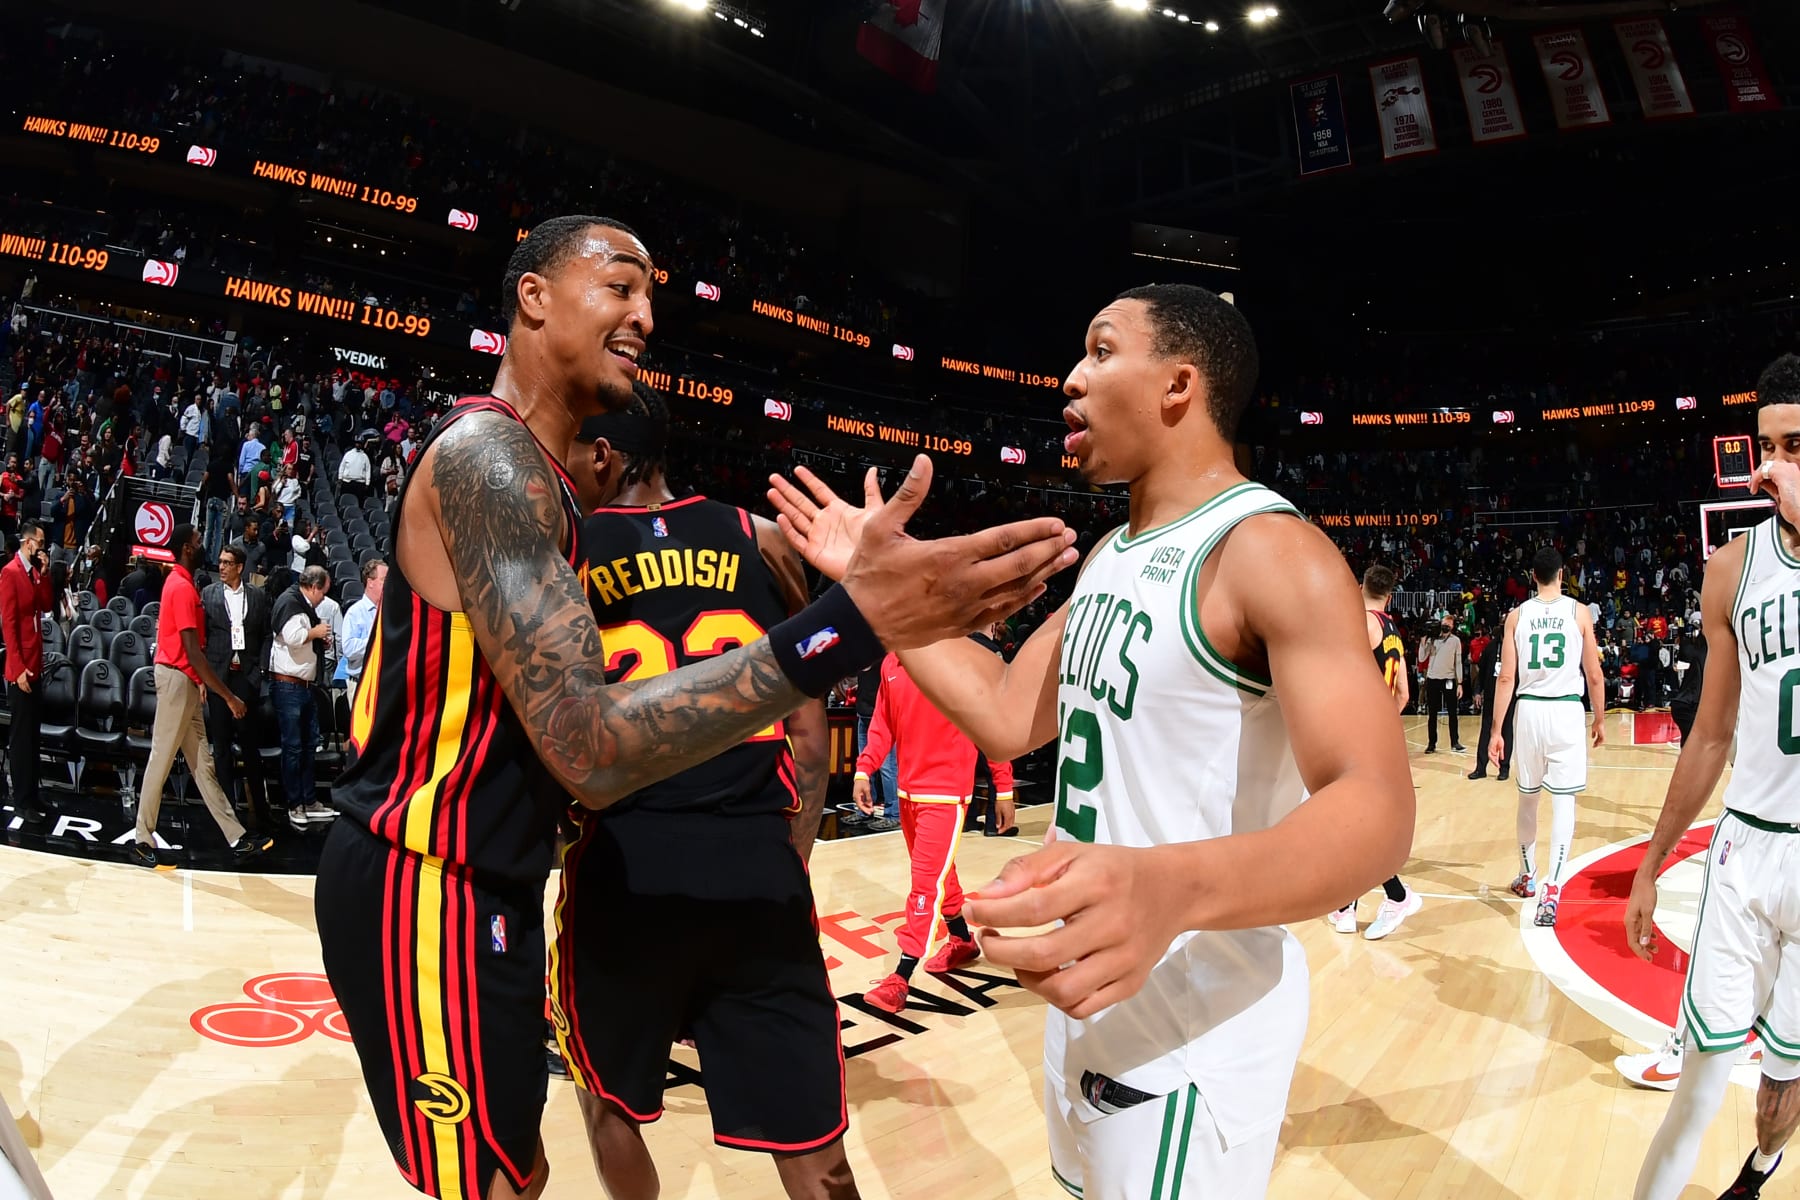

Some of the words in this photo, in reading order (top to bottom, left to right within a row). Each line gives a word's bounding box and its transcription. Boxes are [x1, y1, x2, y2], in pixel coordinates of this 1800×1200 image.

[1482, 98, 1502, 109] 1980
[1394, 114, 1415, 125] 1970
[24, 116, 67, 137] HAWKS
[68, 123, 109, 144] WIN!!!
[109, 130, 160, 154] 110-99
[1313, 129, 1332, 141] 1958
[253, 160, 307, 186] HAWKS
[310, 173, 357, 198] WIN!!!
[361, 186, 417, 213] 110-99
[0, 233, 46, 259] WIN!!!
[48, 242, 109, 271] 110-99
[224, 276, 292, 308] HAWKS
[297, 291, 355, 321] WIN!!!
[361, 305, 431, 337] 110-99
[752, 300, 793, 323] HAWKS
[796, 313, 830, 336] WIN!!!
[833, 325, 871, 348] 110-99
[941, 356, 980, 375] HAWKS
[983, 365, 1015, 382] WIN!!!
[1018, 371, 1059, 388] 110-99
[636, 368, 672, 392] IN!!!
[677, 378, 733, 406] 110-99
[1722, 391, 1758, 405] HAWKS
[1352, 414, 1392, 425] HAWKS
[1394, 413, 1428, 424] WIN!!!
[1431, 412, 1471, 424] 110-99
[1542, 407, 1581, 420] HAWKS
[1582, 403, 1615, 417] WIN!!!
[1618, 400, 1655, 413] 110-99
[827, 415, 875, 438] HAWKS
[879, 426, 919, 447] WIN!!!
[924, 434, 972, 456] 110-99
[1724, 441, 1741, 454] 0.0
[1355, 514, 1392, 526] WIN!!!
[1150, 546, 1185, 568] VISTA
[589, 548, 740, 606] REDDISH
[1140, 565, 1176, 584] PRINT
[1529, 617, 1564, 631] KANTER
[1060, 593, 1152, 722] ELTICS
[1527, 632, 1566, 670] 13
